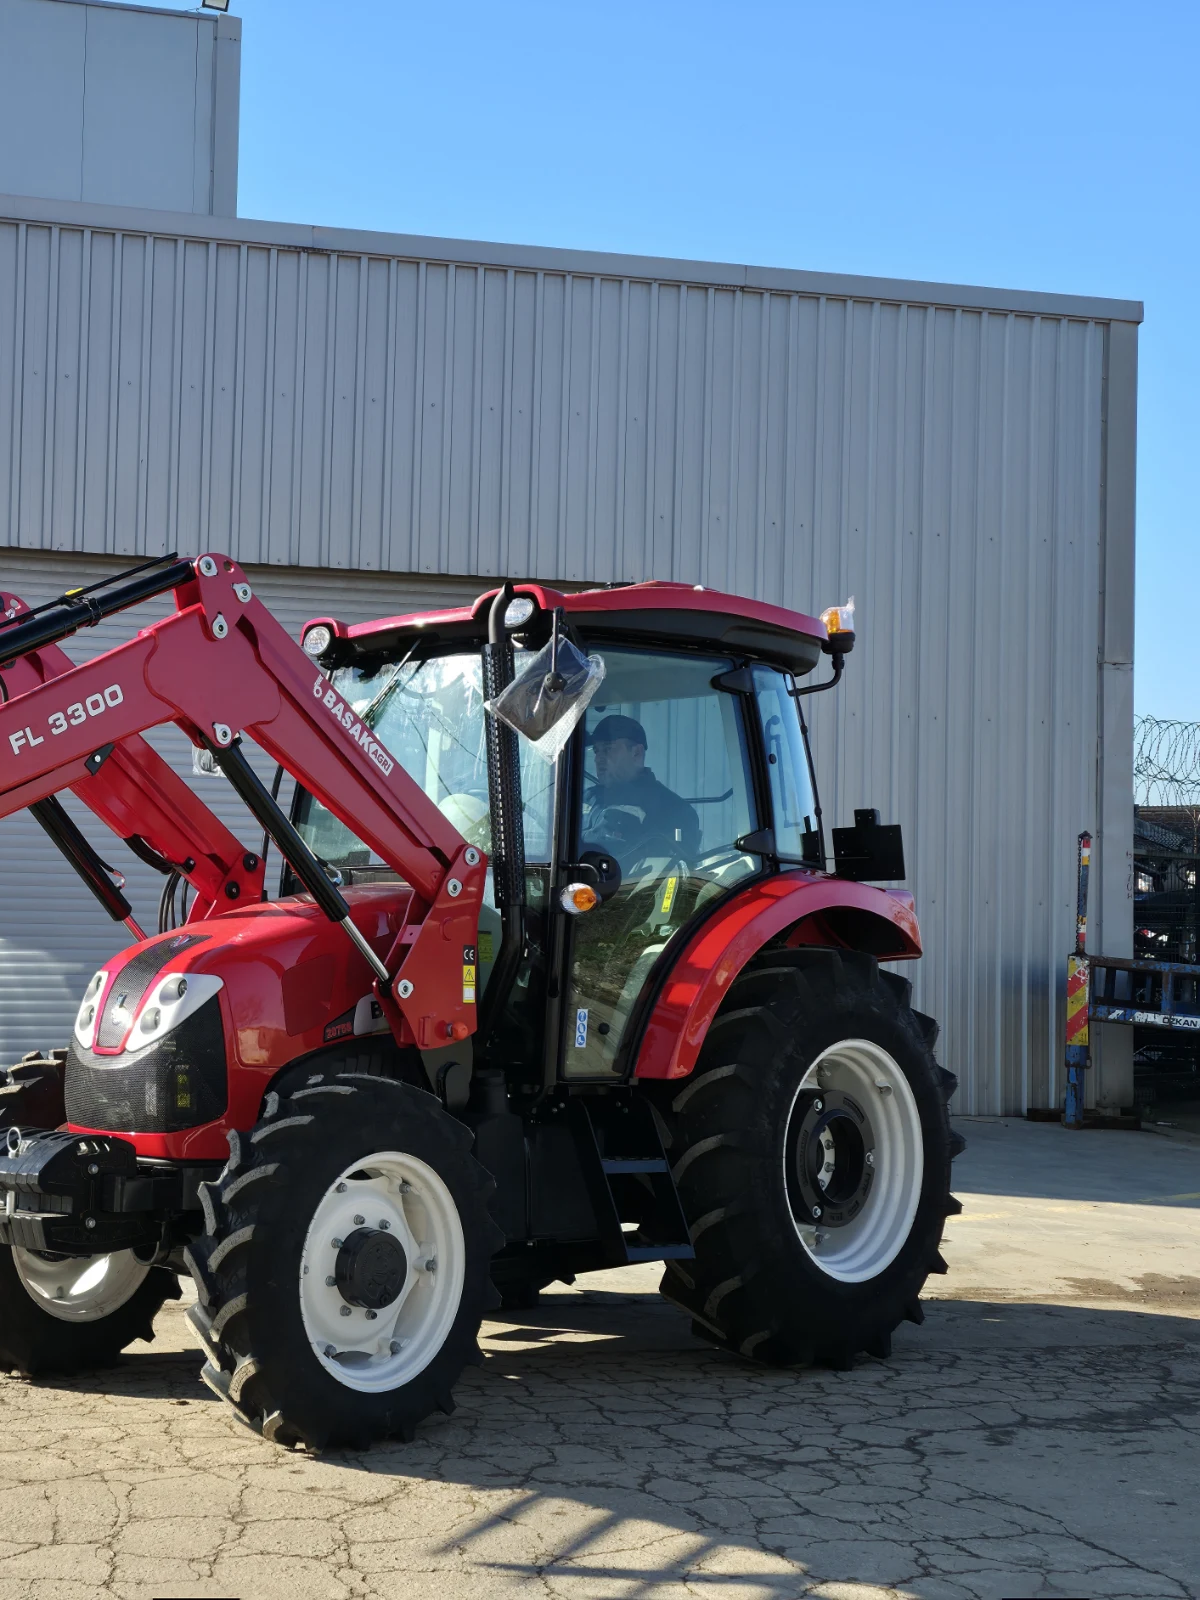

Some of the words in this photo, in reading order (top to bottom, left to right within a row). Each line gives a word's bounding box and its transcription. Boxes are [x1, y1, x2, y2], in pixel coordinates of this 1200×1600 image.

[8, 726, 45, 756] FL
[47, 682, 124, 737] 3300
[371, 748, 391, 772] AGRI
